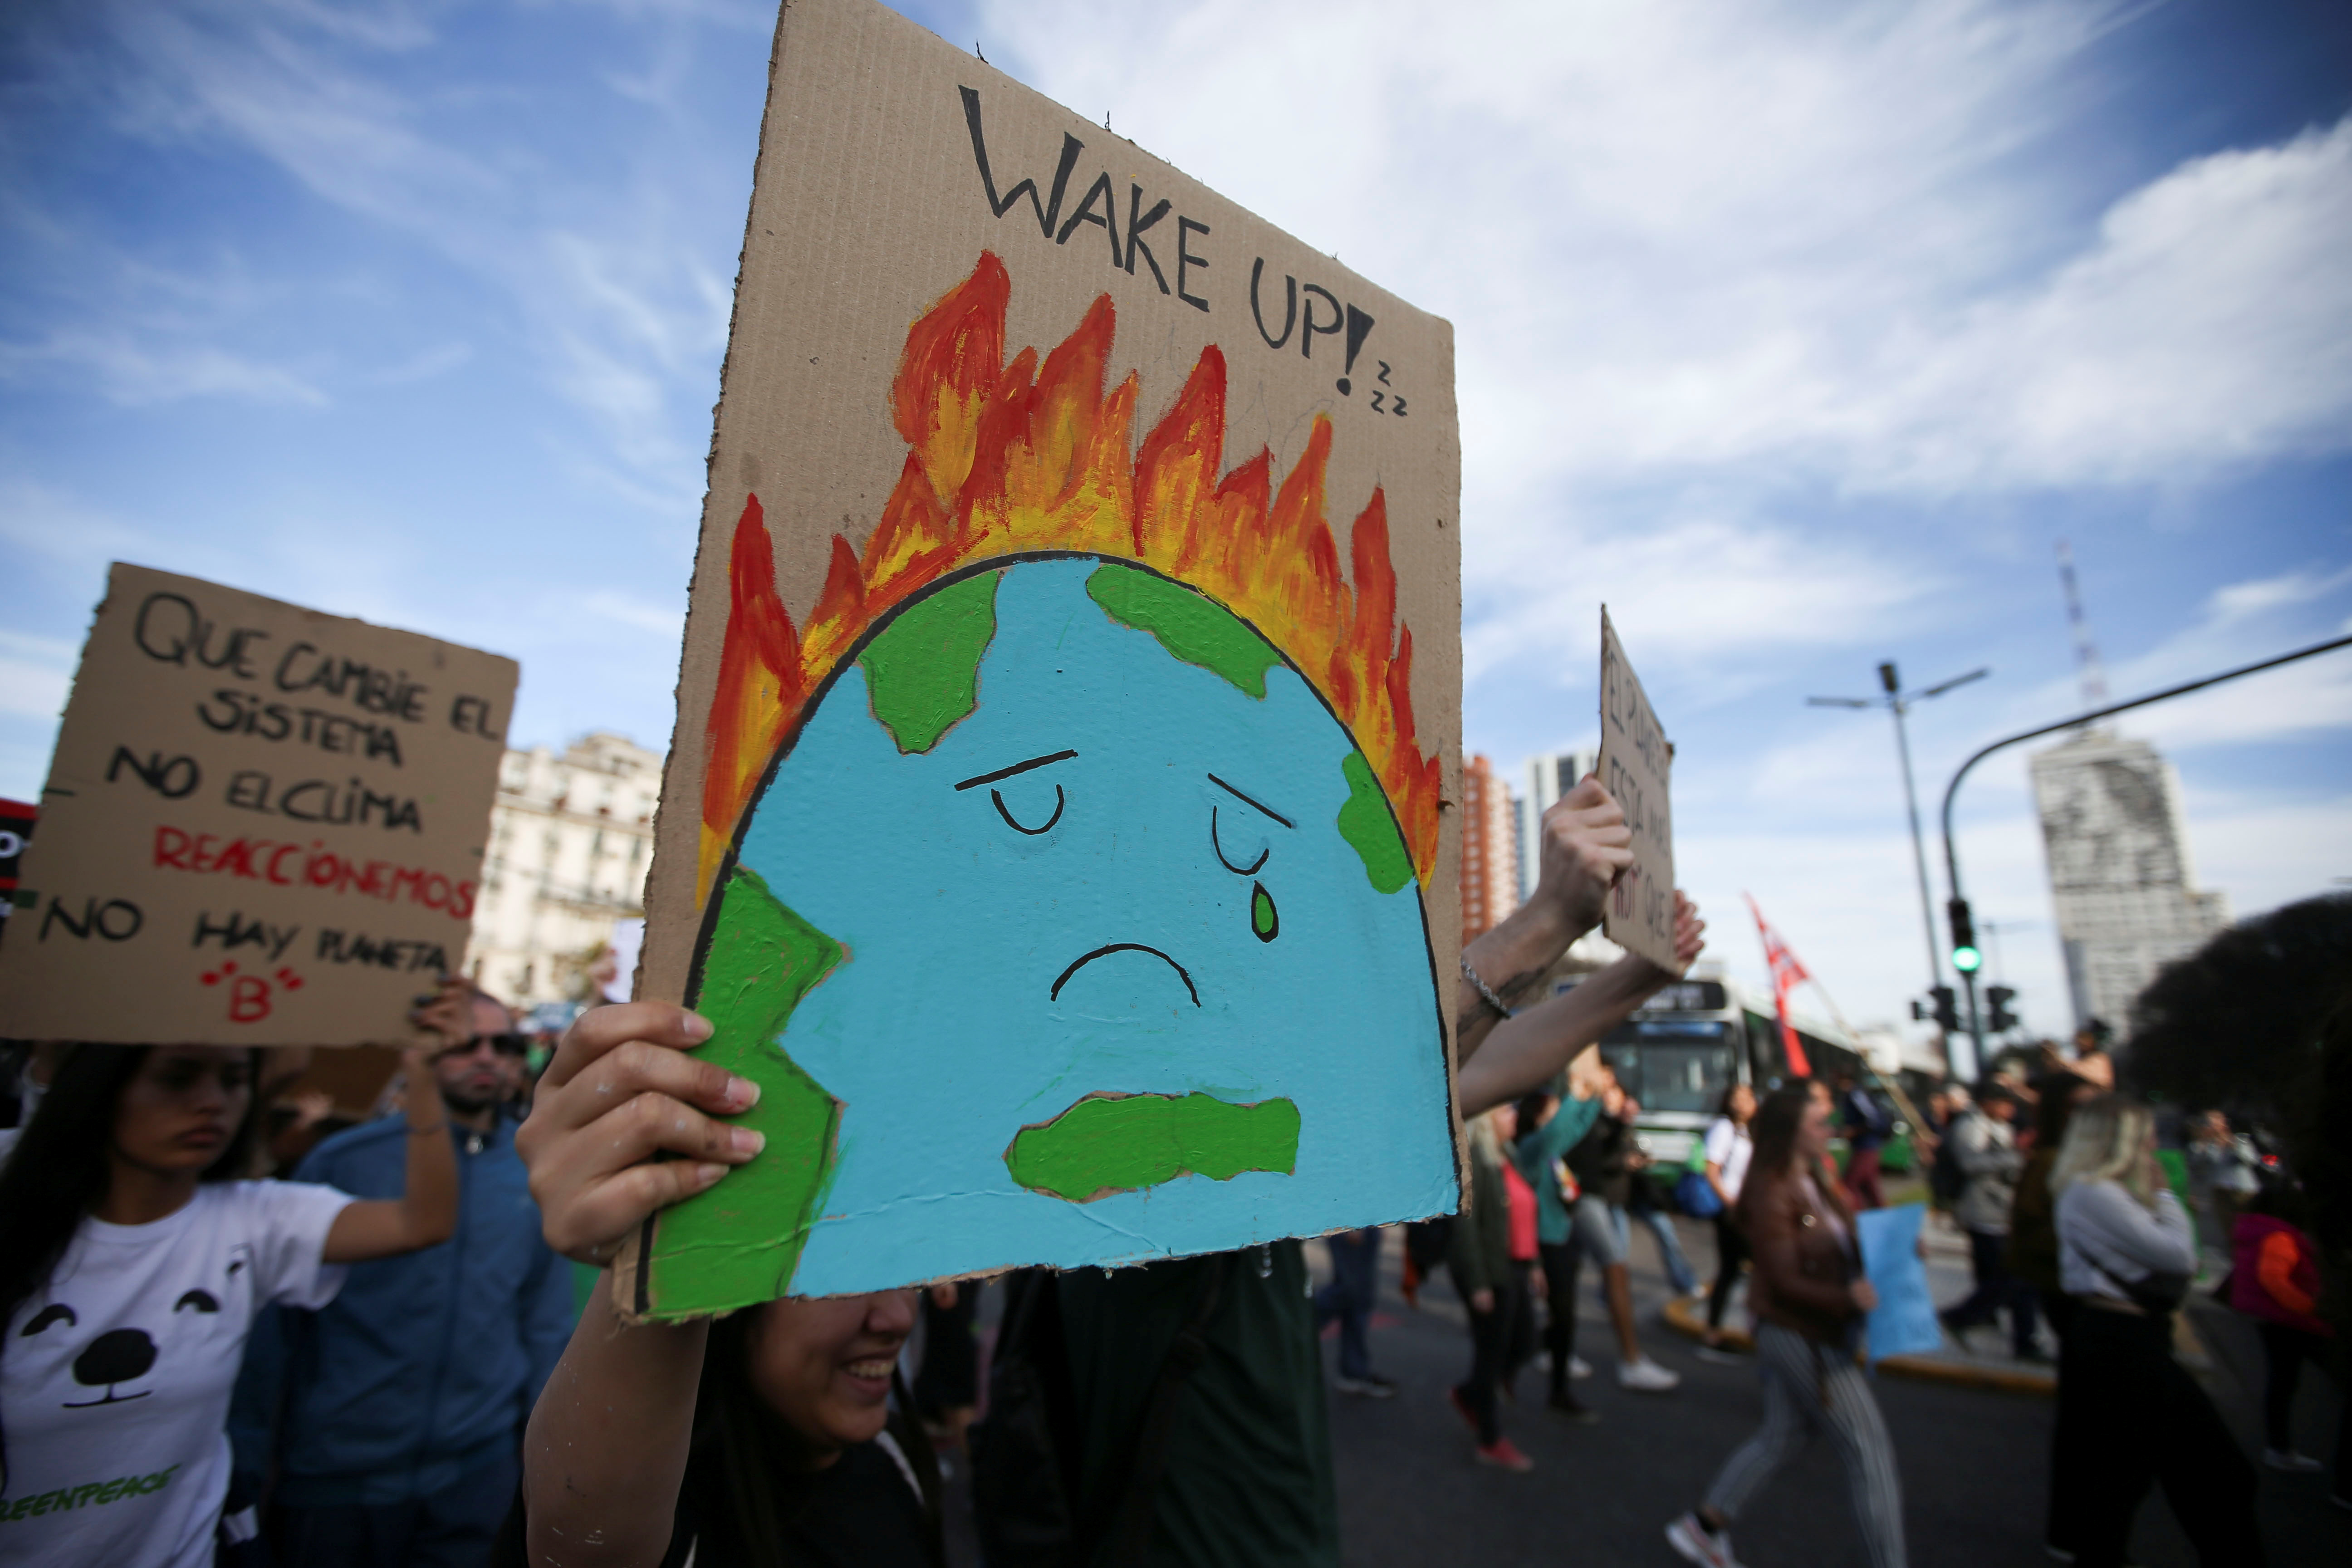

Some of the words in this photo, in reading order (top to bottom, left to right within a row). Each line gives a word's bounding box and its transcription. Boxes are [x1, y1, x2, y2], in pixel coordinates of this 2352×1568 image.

[958, 84, 1210, 313] WAKE
[1251, 257, 1375, 396] UP!
[134, 592, 268, 680] QUE
[451, 695, 499, 741] EL
[105, 745, 199, 799] NO
[39, 897, 143, 943] NO
[191, 911, 300, 962] HAY
[317, 929, 447, 973] PLANETA
[0, 1464, 182, 1522] REENPEACE
